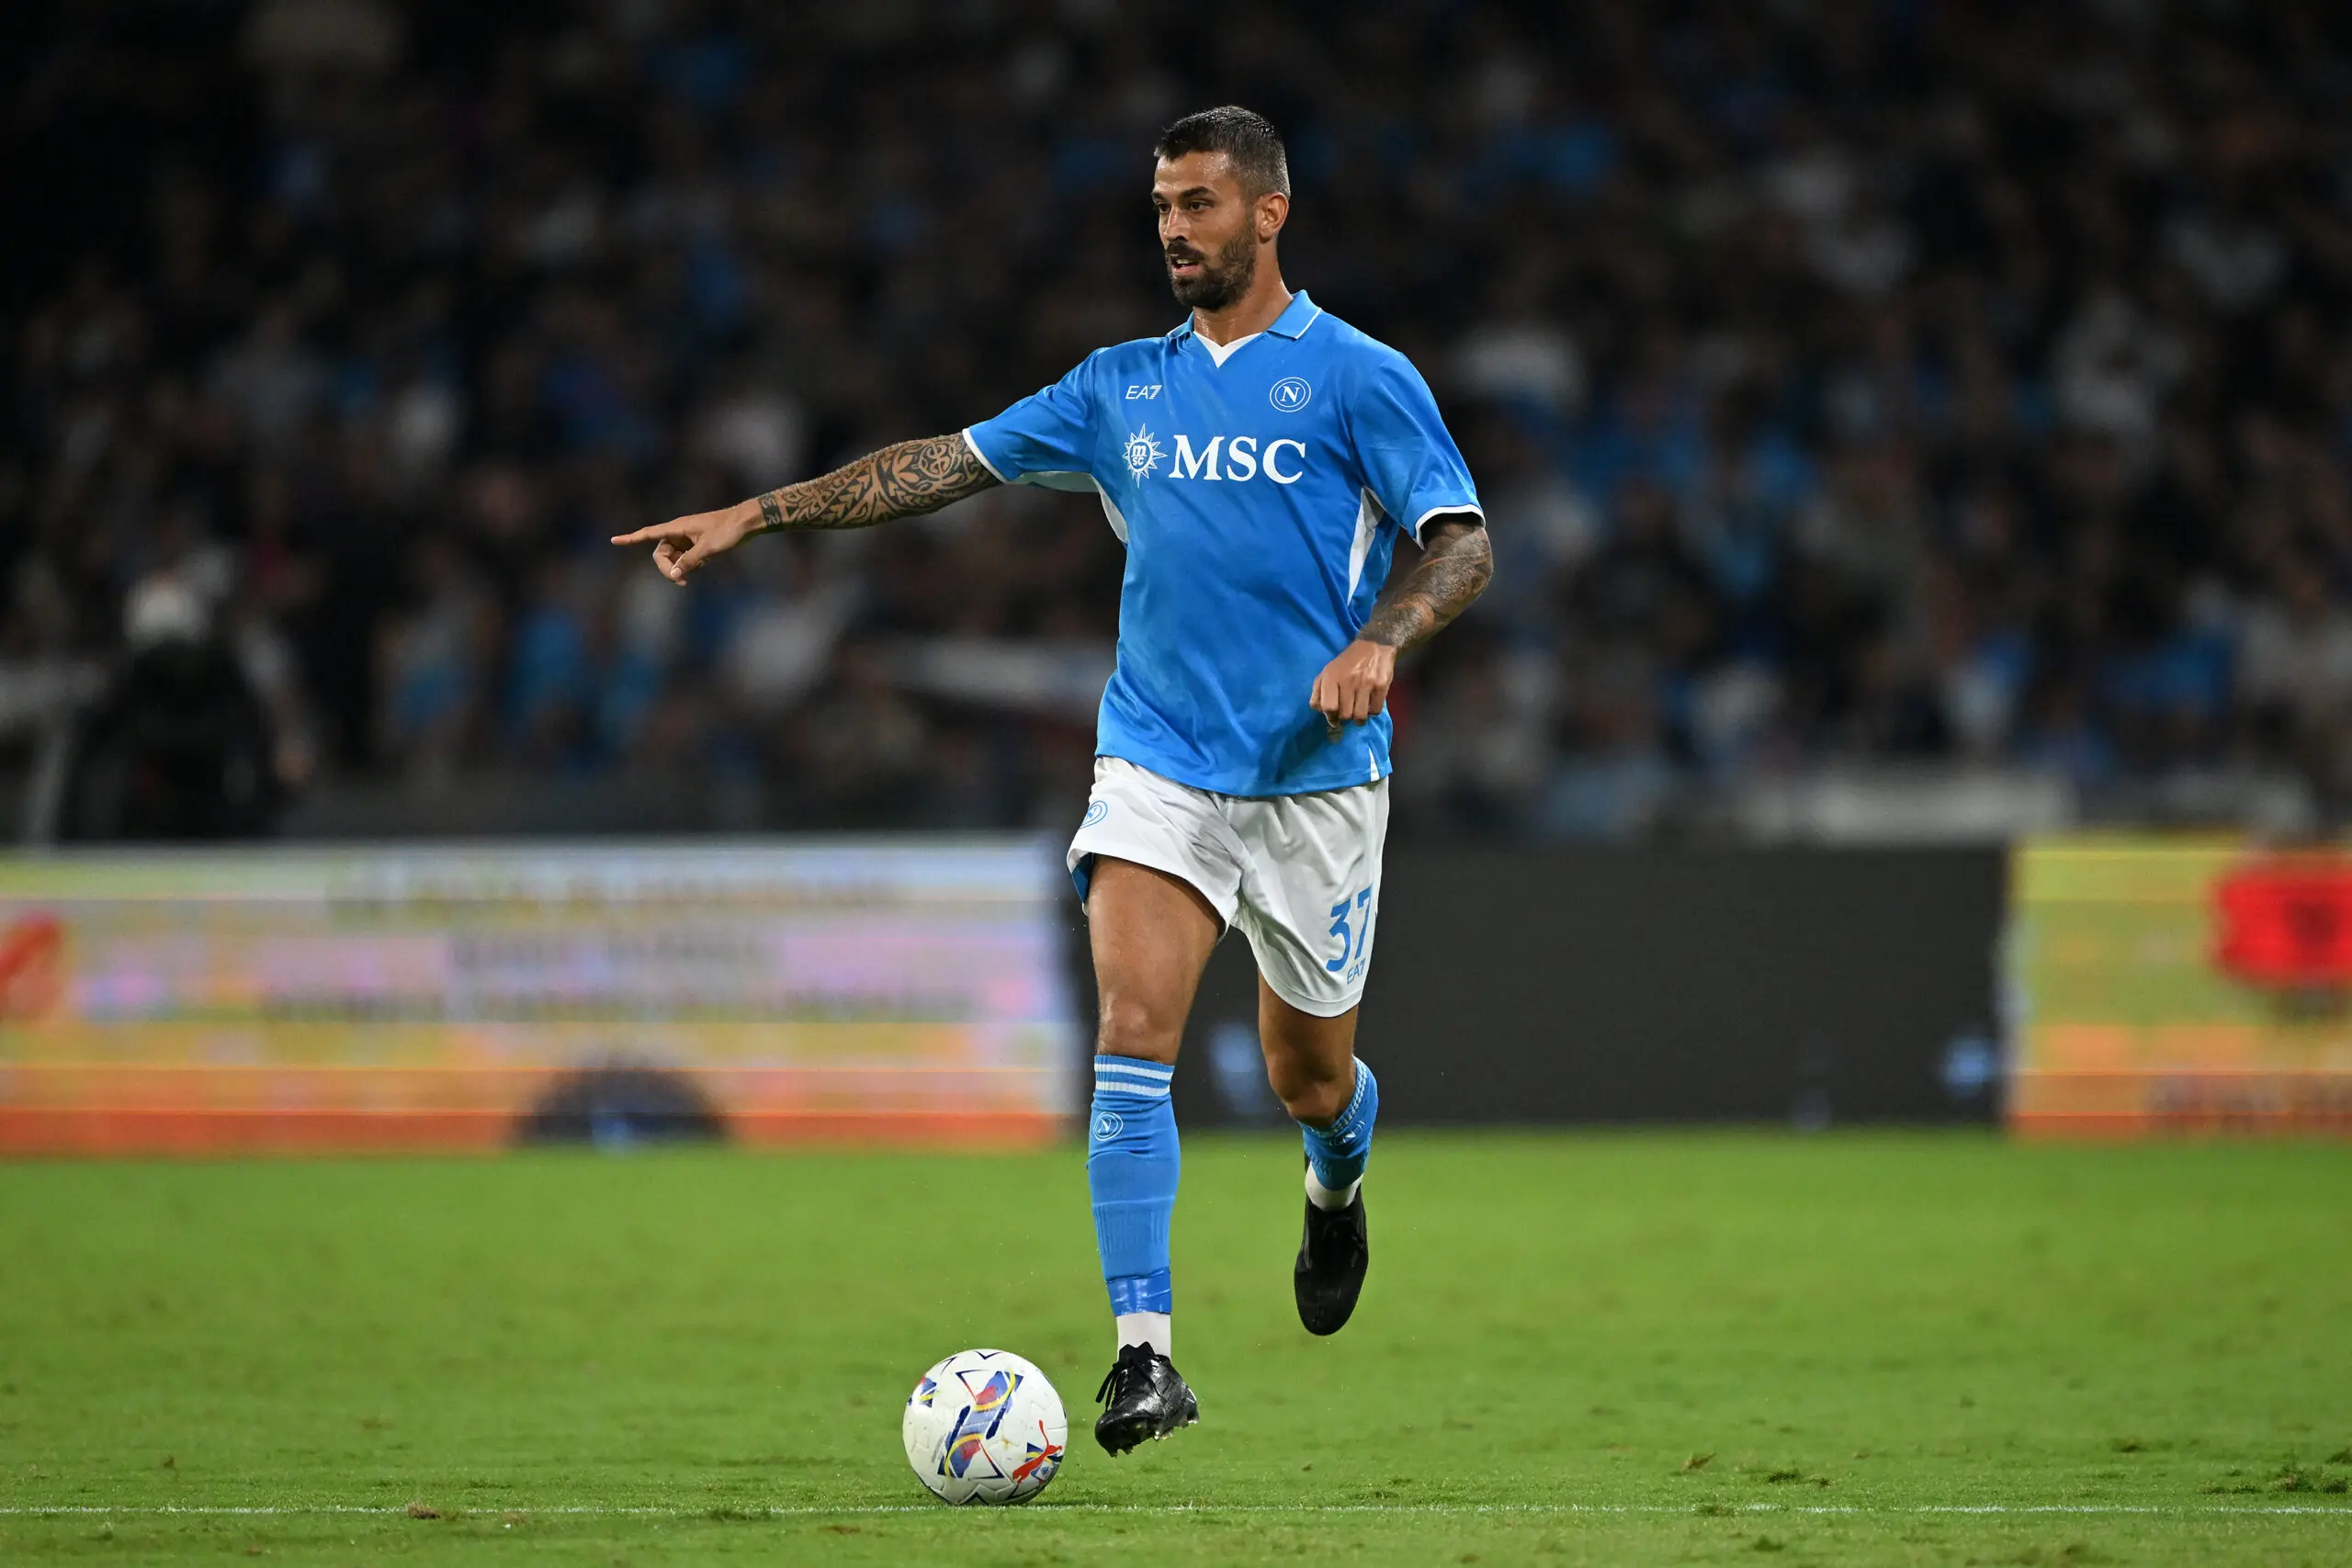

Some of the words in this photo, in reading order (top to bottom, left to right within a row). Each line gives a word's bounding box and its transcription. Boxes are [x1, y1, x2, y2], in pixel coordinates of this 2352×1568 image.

[1125, 385, 1162, 400] EA7
[1280, 386, 1300, 402] N
[1168, 434, 1306, 484] MSC
[1326, 882, 1374, 973] 37
[1347, 957, 1366, 985] EA7
